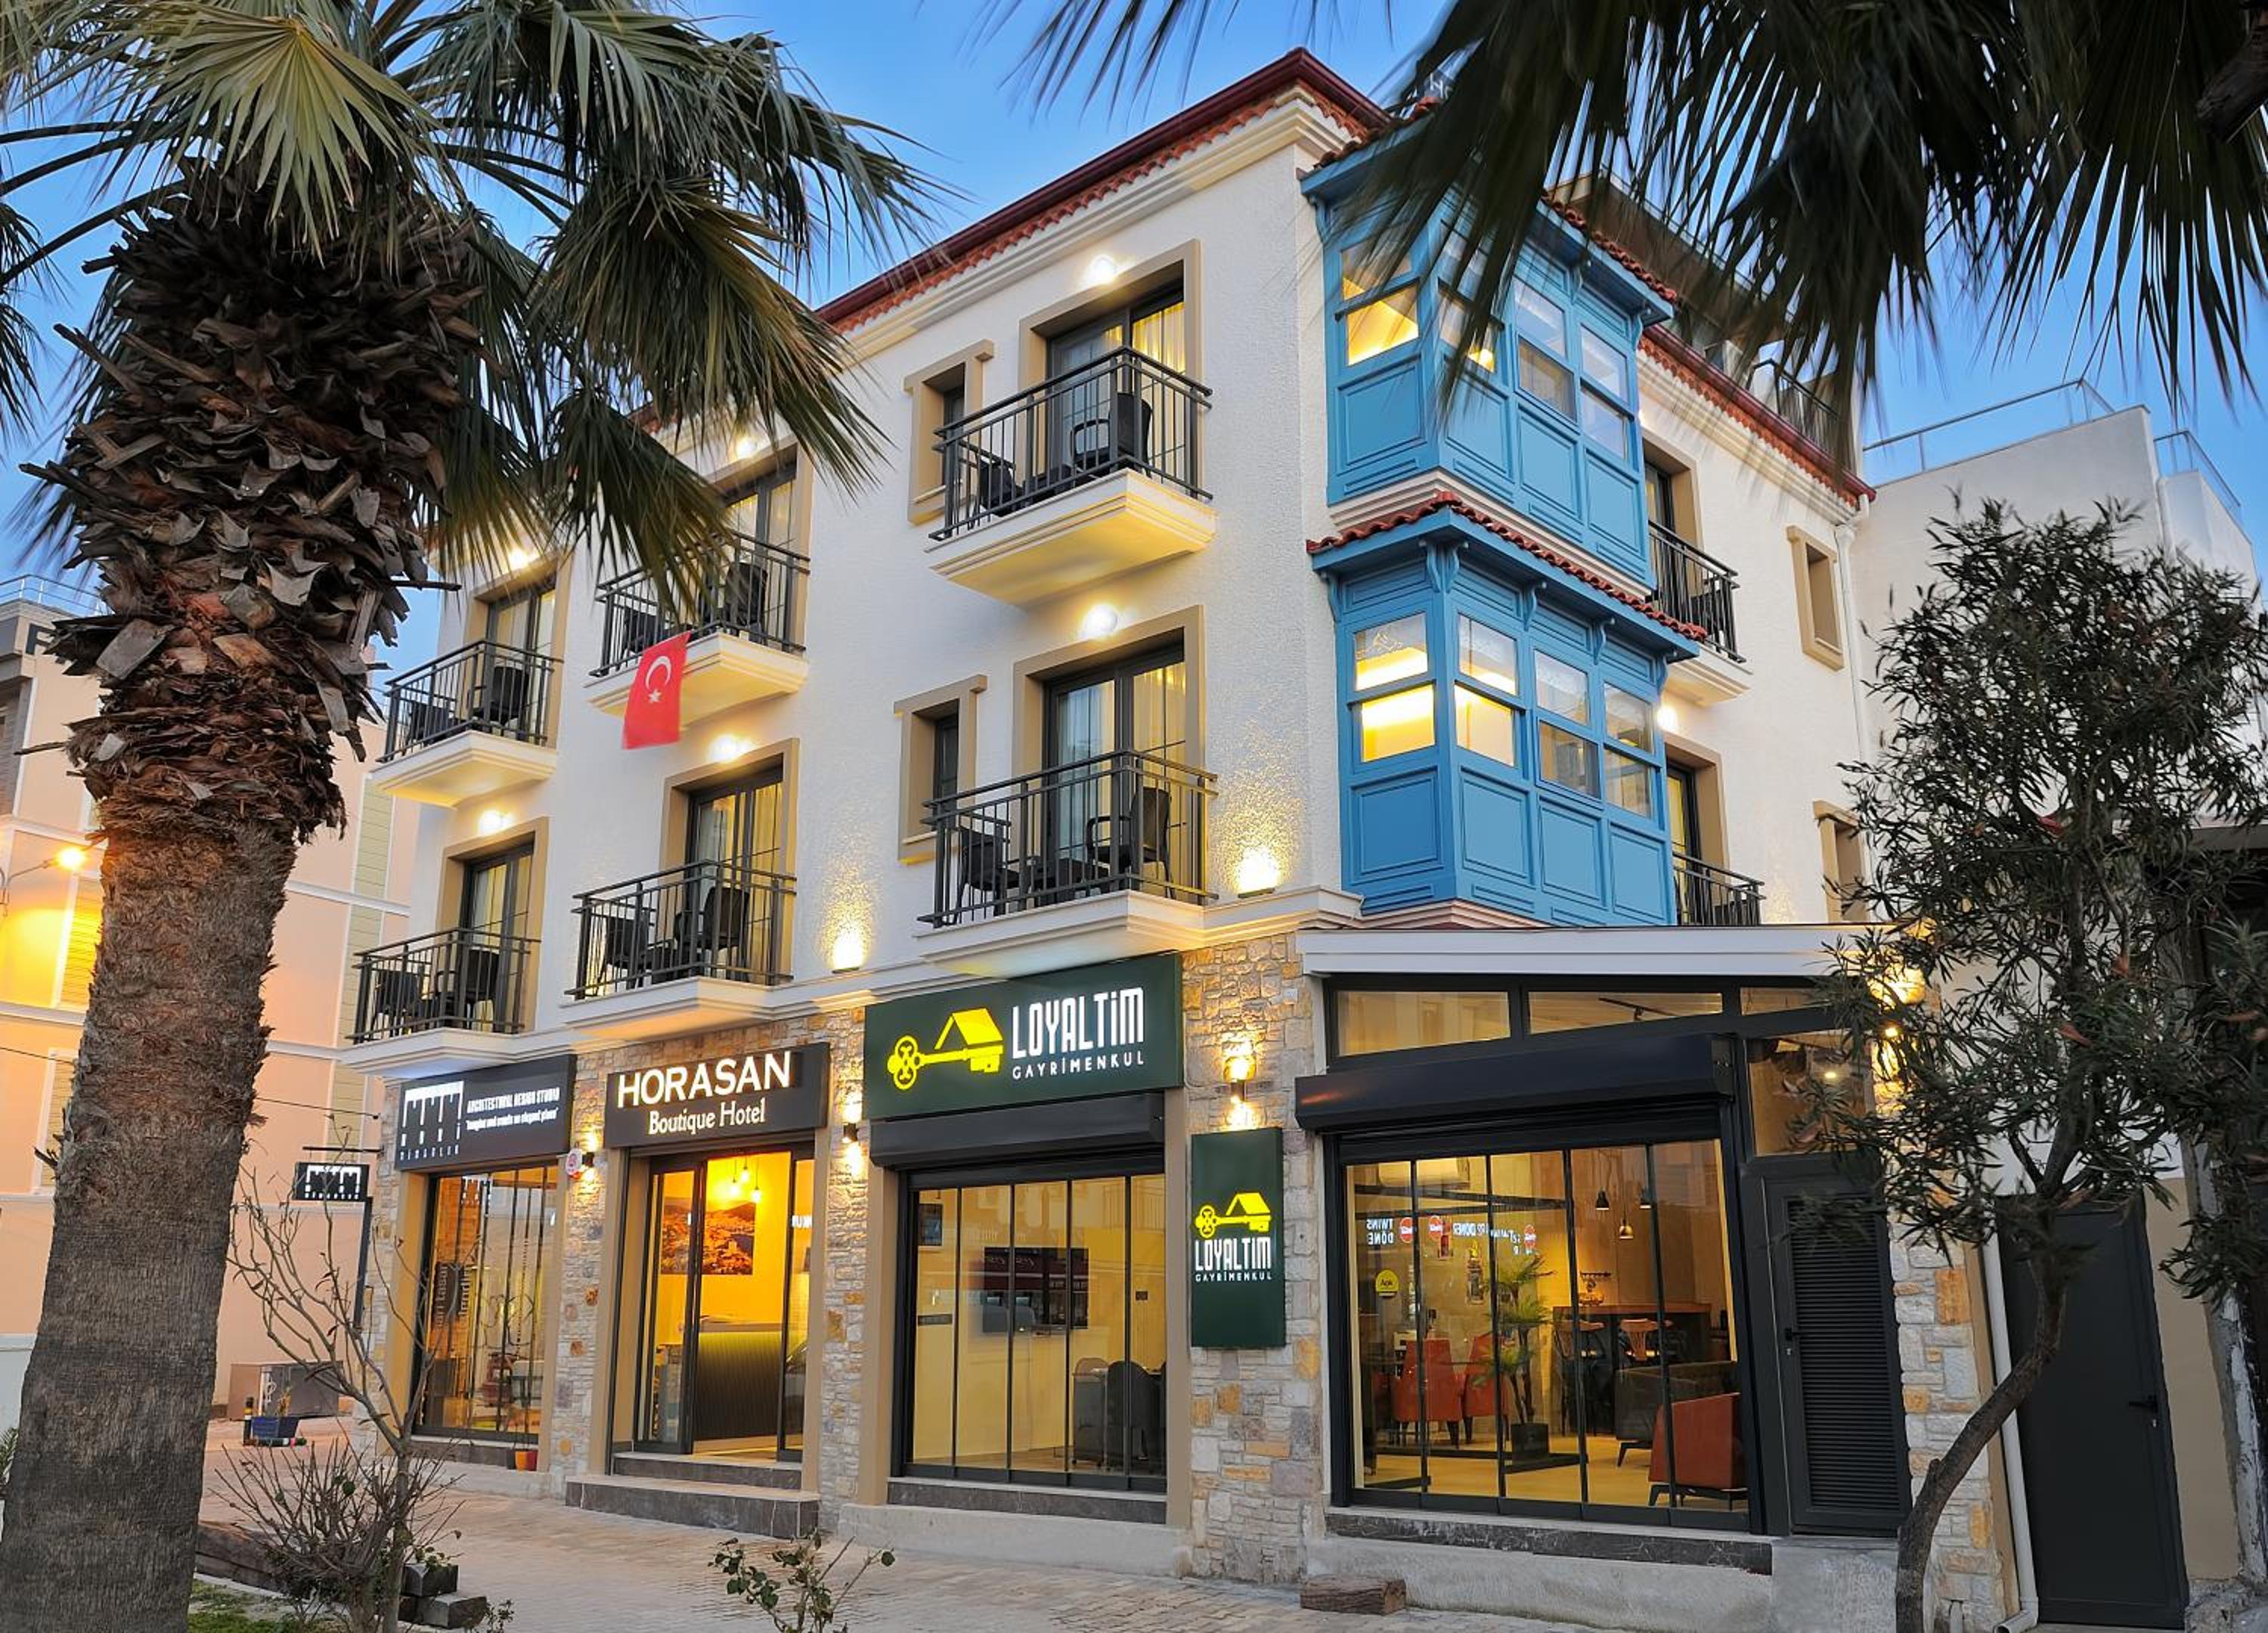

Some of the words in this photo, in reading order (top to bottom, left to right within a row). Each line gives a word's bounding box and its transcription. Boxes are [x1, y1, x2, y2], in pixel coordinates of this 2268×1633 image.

[617, 1051, 792, 1109] HORASAN
[649, 1108, 715, 1135] Boutique
[719, 1097, 766, 1127] Hotel
